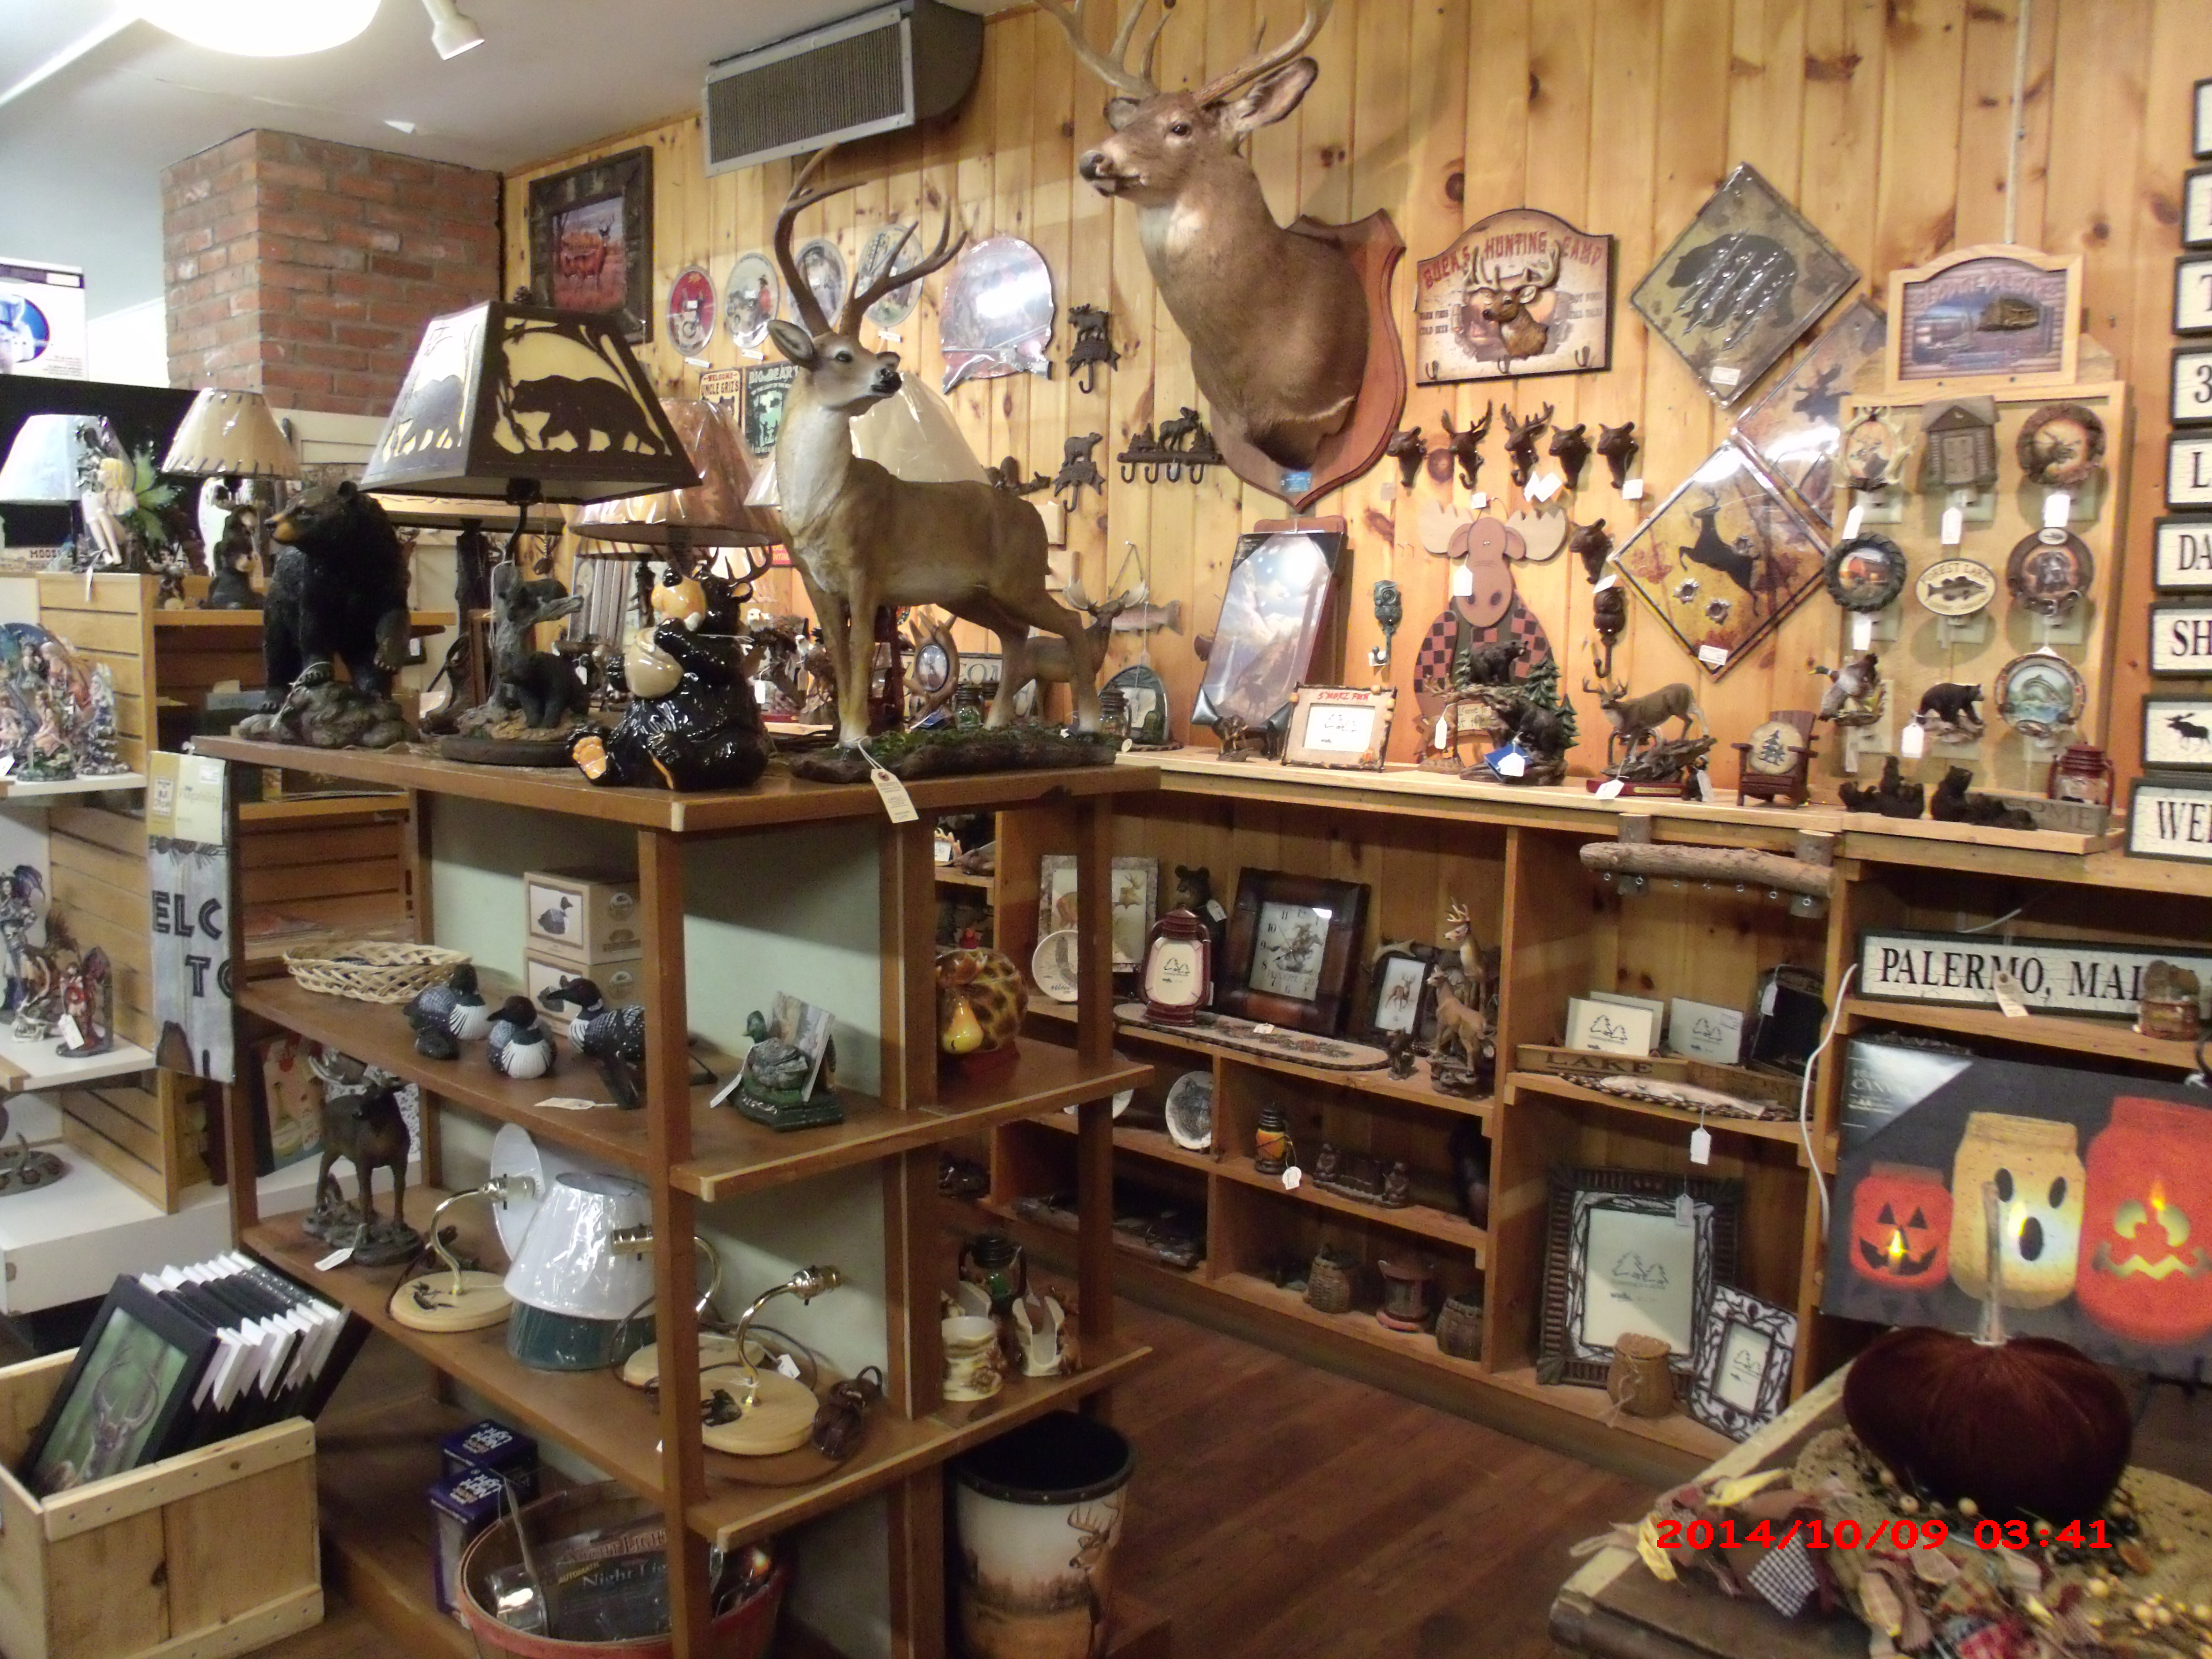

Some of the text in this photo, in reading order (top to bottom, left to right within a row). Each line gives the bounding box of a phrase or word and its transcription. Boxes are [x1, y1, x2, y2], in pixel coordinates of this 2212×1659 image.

[1485, 231, 1547, 259] HUNTING
[1562, 236, 1603, 265] CAMP
[2156, 801, 2212, 841] WE
[1267, 923, 1277, 933] 10
[1880, 947, 2051, 1005] PALERMO,
[2067, 961, 2142, 1001] MAI
[1546, 1052, 1652, 1074] LAKE
